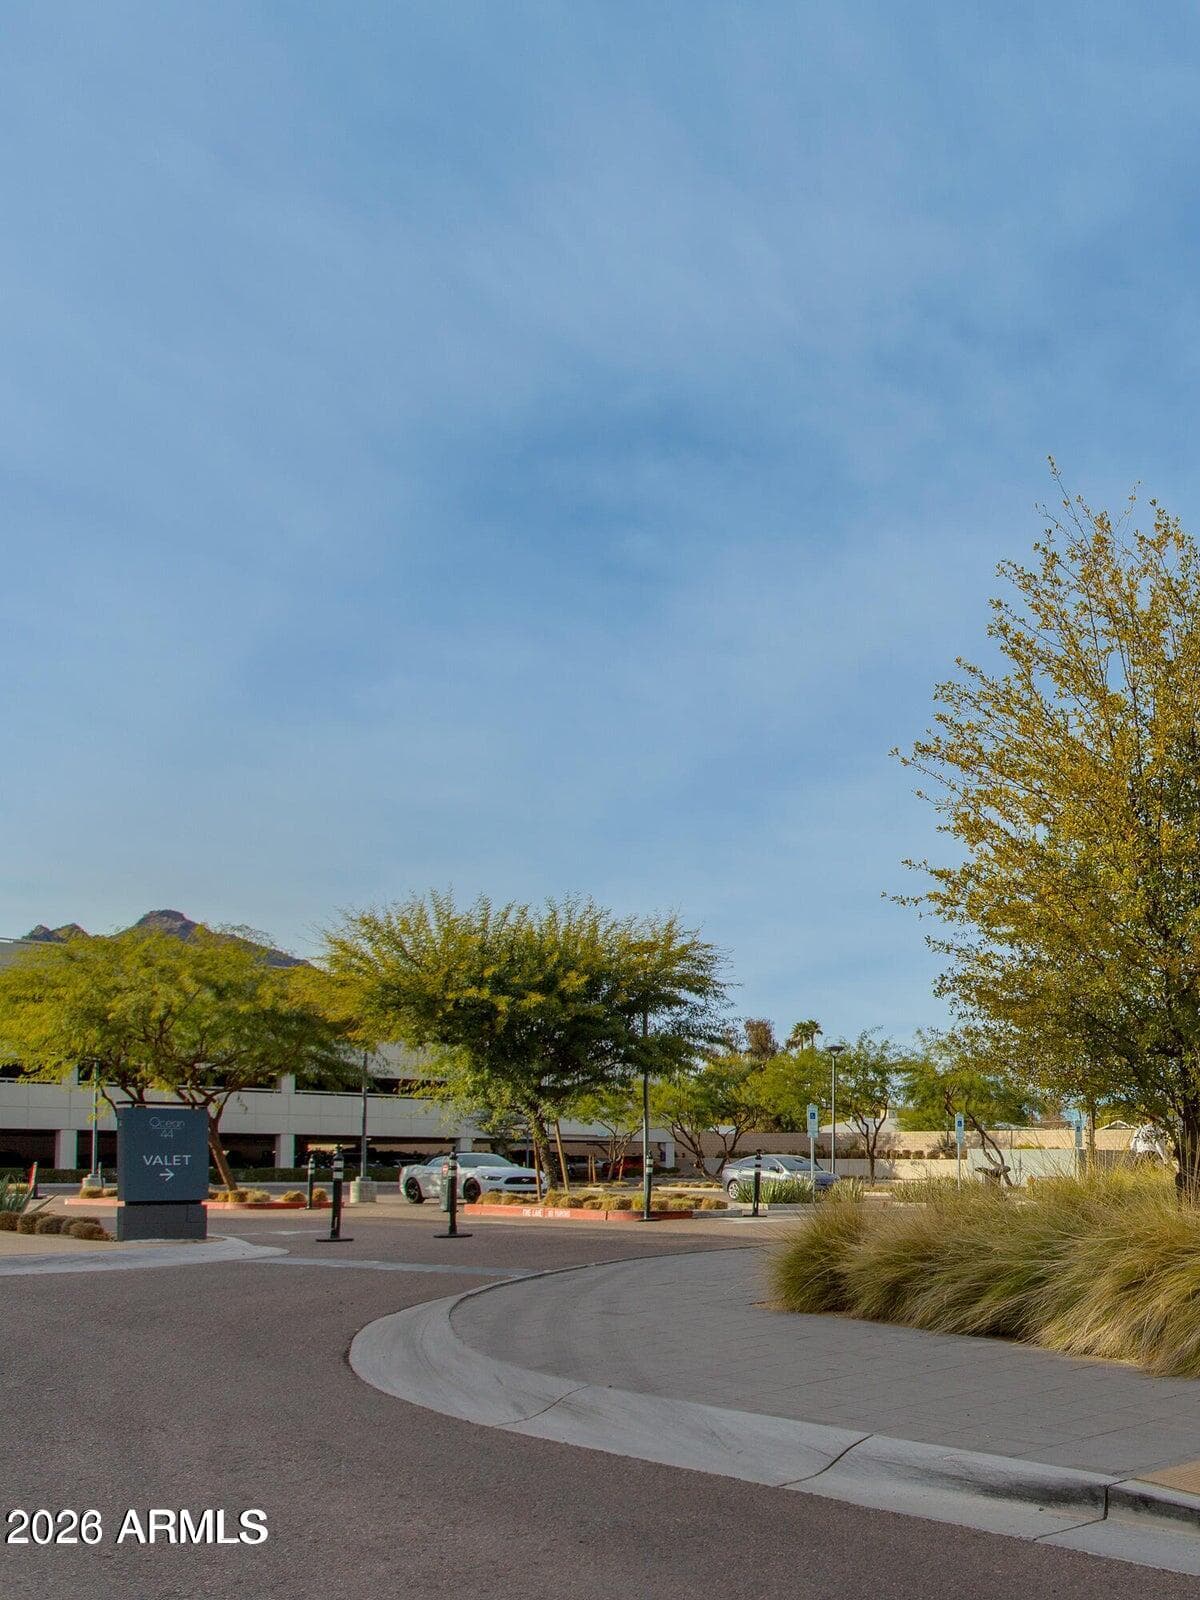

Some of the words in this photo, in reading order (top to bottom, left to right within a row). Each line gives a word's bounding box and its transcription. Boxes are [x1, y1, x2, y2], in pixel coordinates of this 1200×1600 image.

[149, 1116, 186, 1129] Ocean
[160, 1129, 174, 1138] 44
[143, 1155, 192, 1166] VALET
